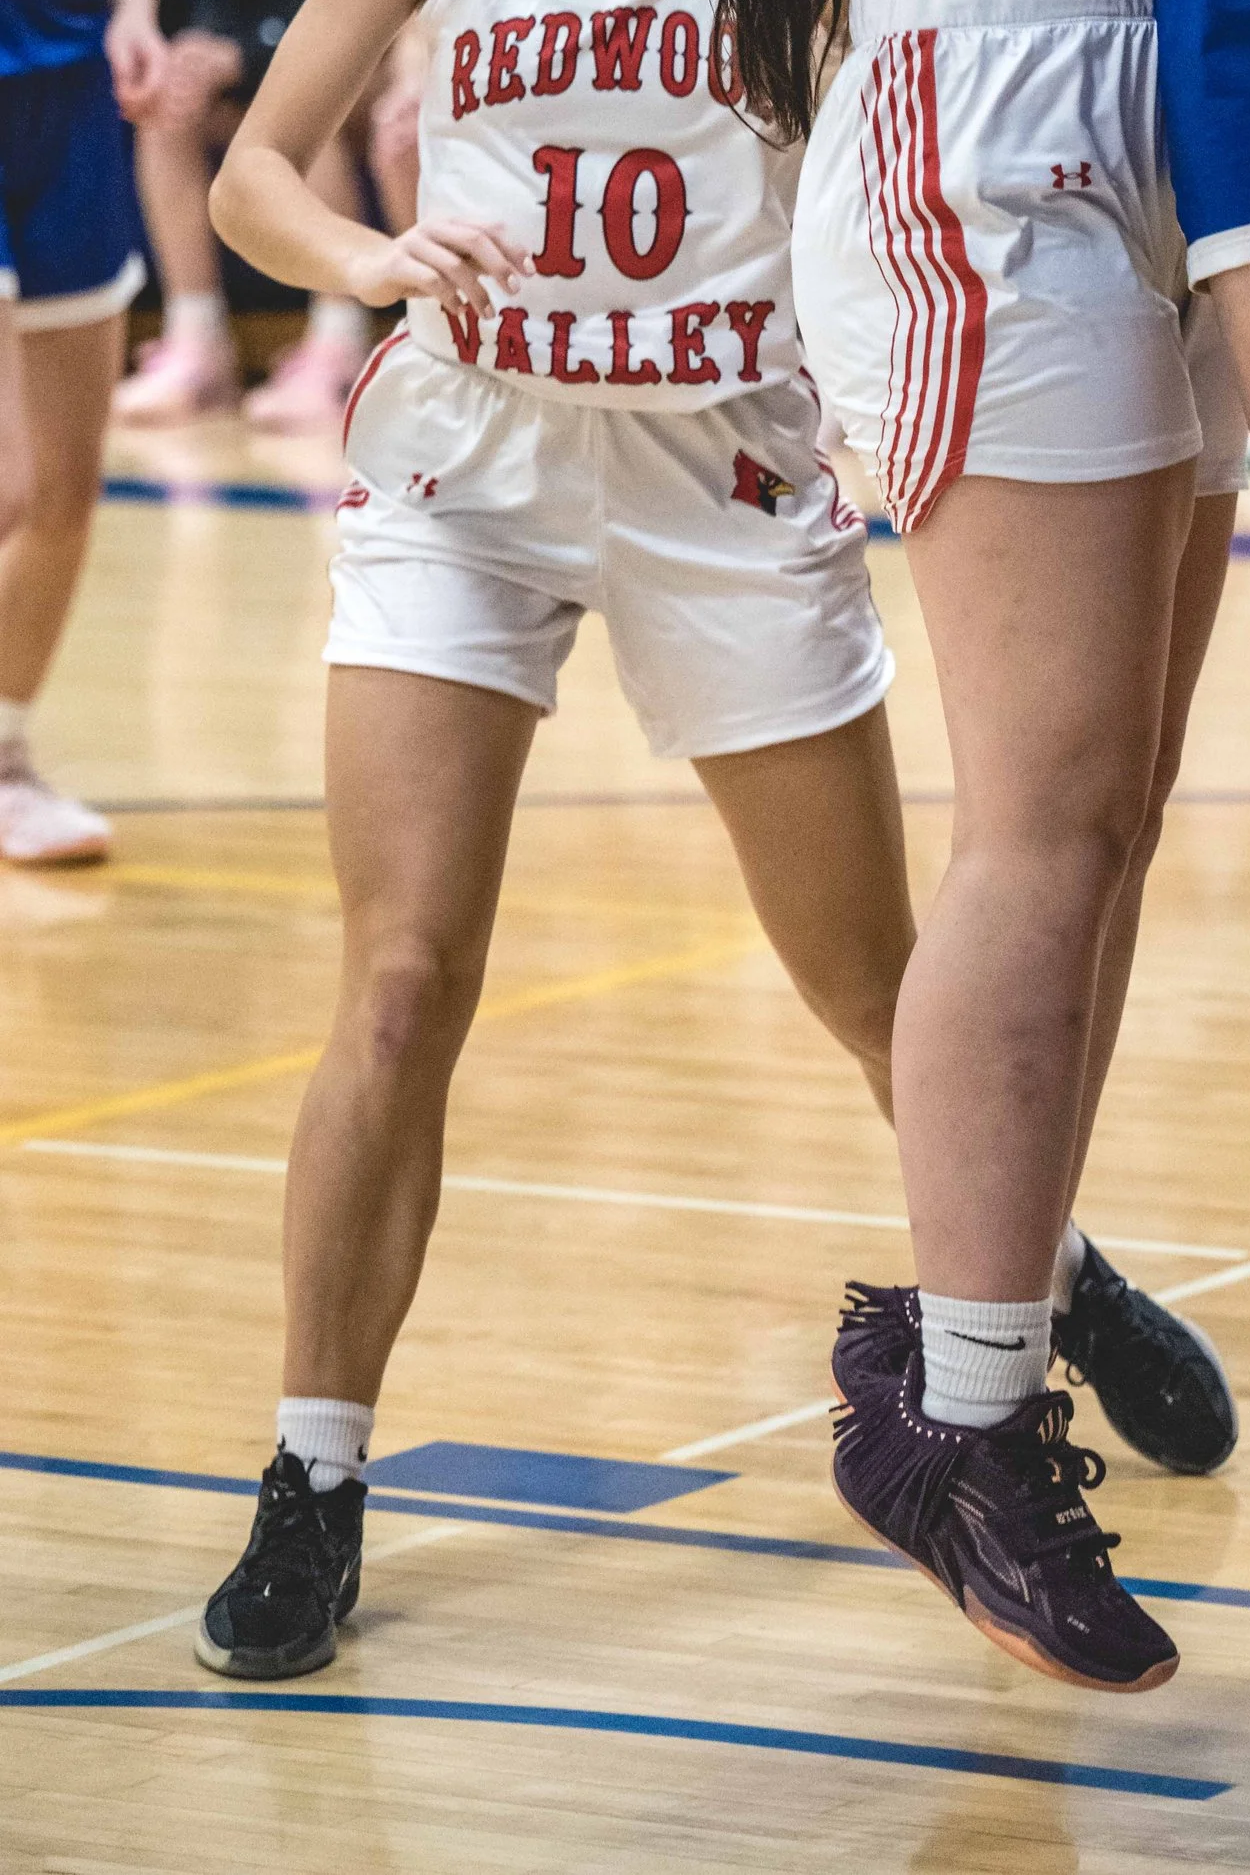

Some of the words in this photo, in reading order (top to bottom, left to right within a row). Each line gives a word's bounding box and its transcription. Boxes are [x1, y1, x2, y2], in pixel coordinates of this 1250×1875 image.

[450, 4, 775, 126] REDWOO
[531, 144, 692, 280] 10
[440, 299, 775, 387] VALLEY
